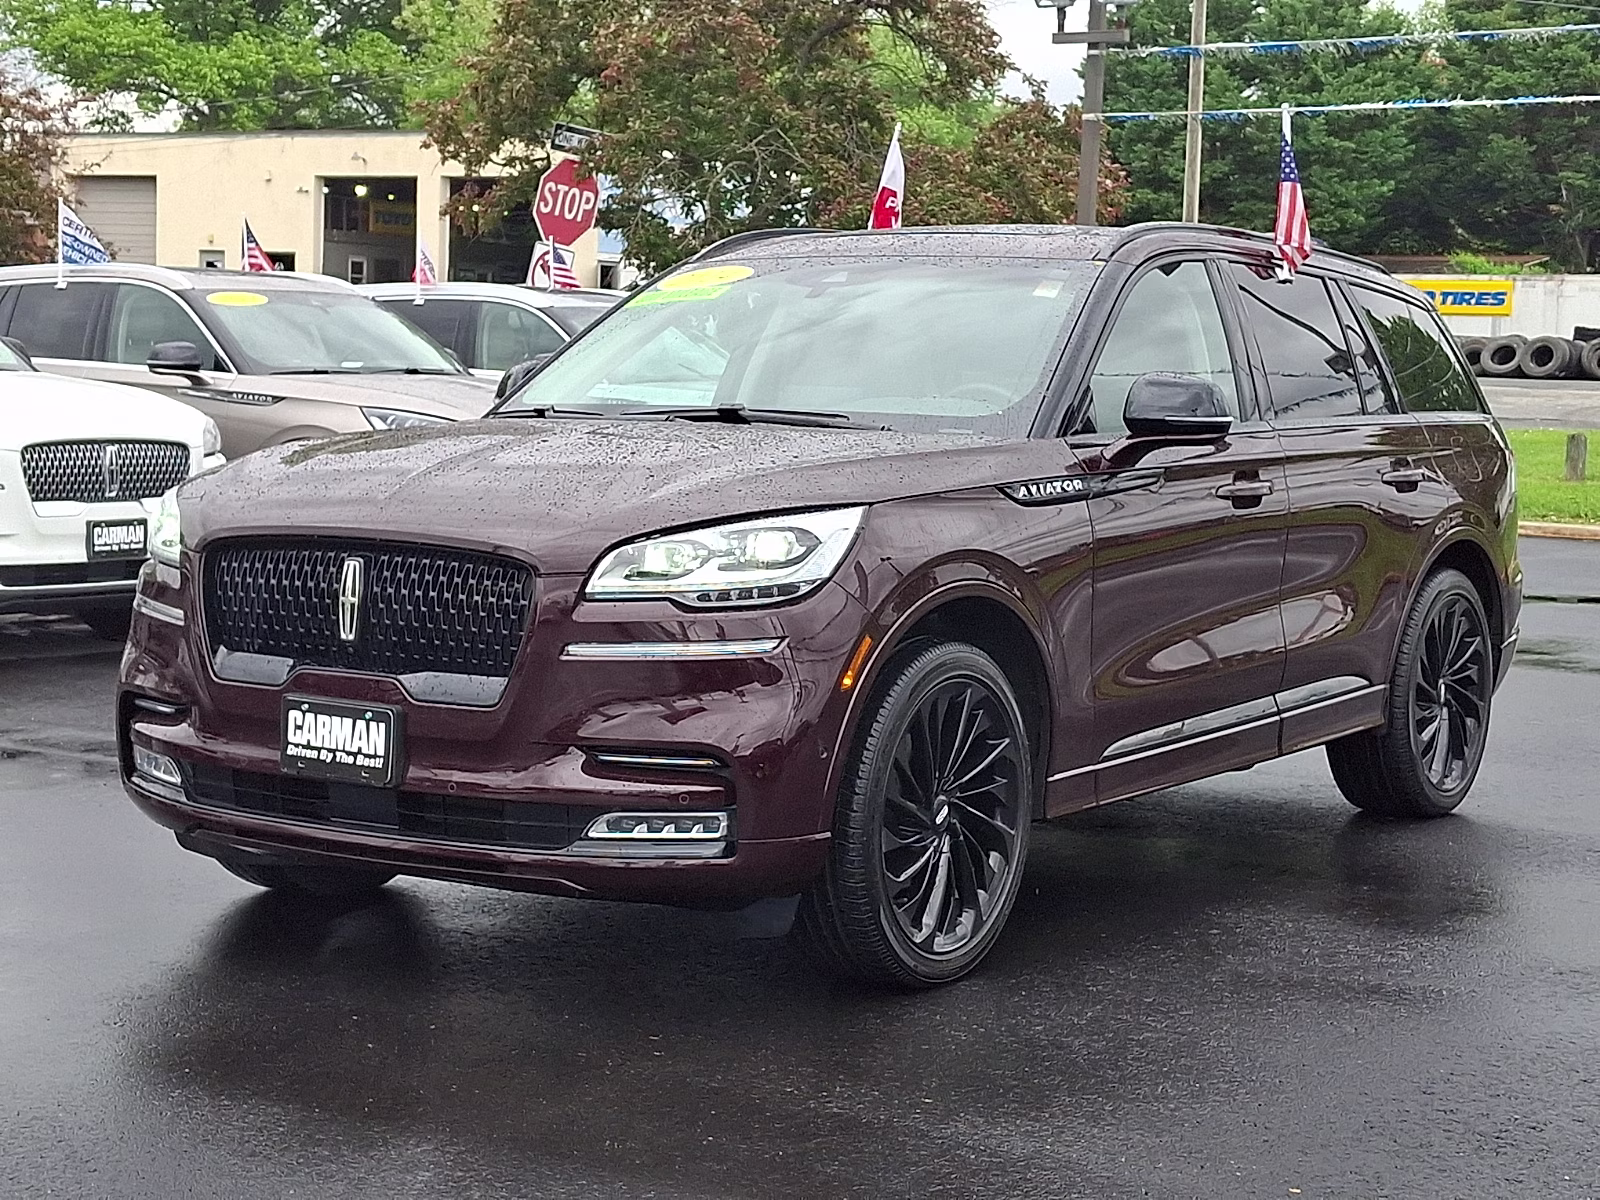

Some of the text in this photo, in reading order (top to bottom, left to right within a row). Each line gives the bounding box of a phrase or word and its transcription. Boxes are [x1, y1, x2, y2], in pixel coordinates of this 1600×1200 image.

[540, 181, 595, 222] STOP
[1440, 291, 1508, 306] TIRES
[232, 392, 273, 403] AVIATOR
[1018, 479, 1083, 498] AVIATOR
[93, 525, 144, 545] CARMAN
[287, 709, 386, 757] CARMAN
[286, 744, 384, 768] Driven By The Best!
